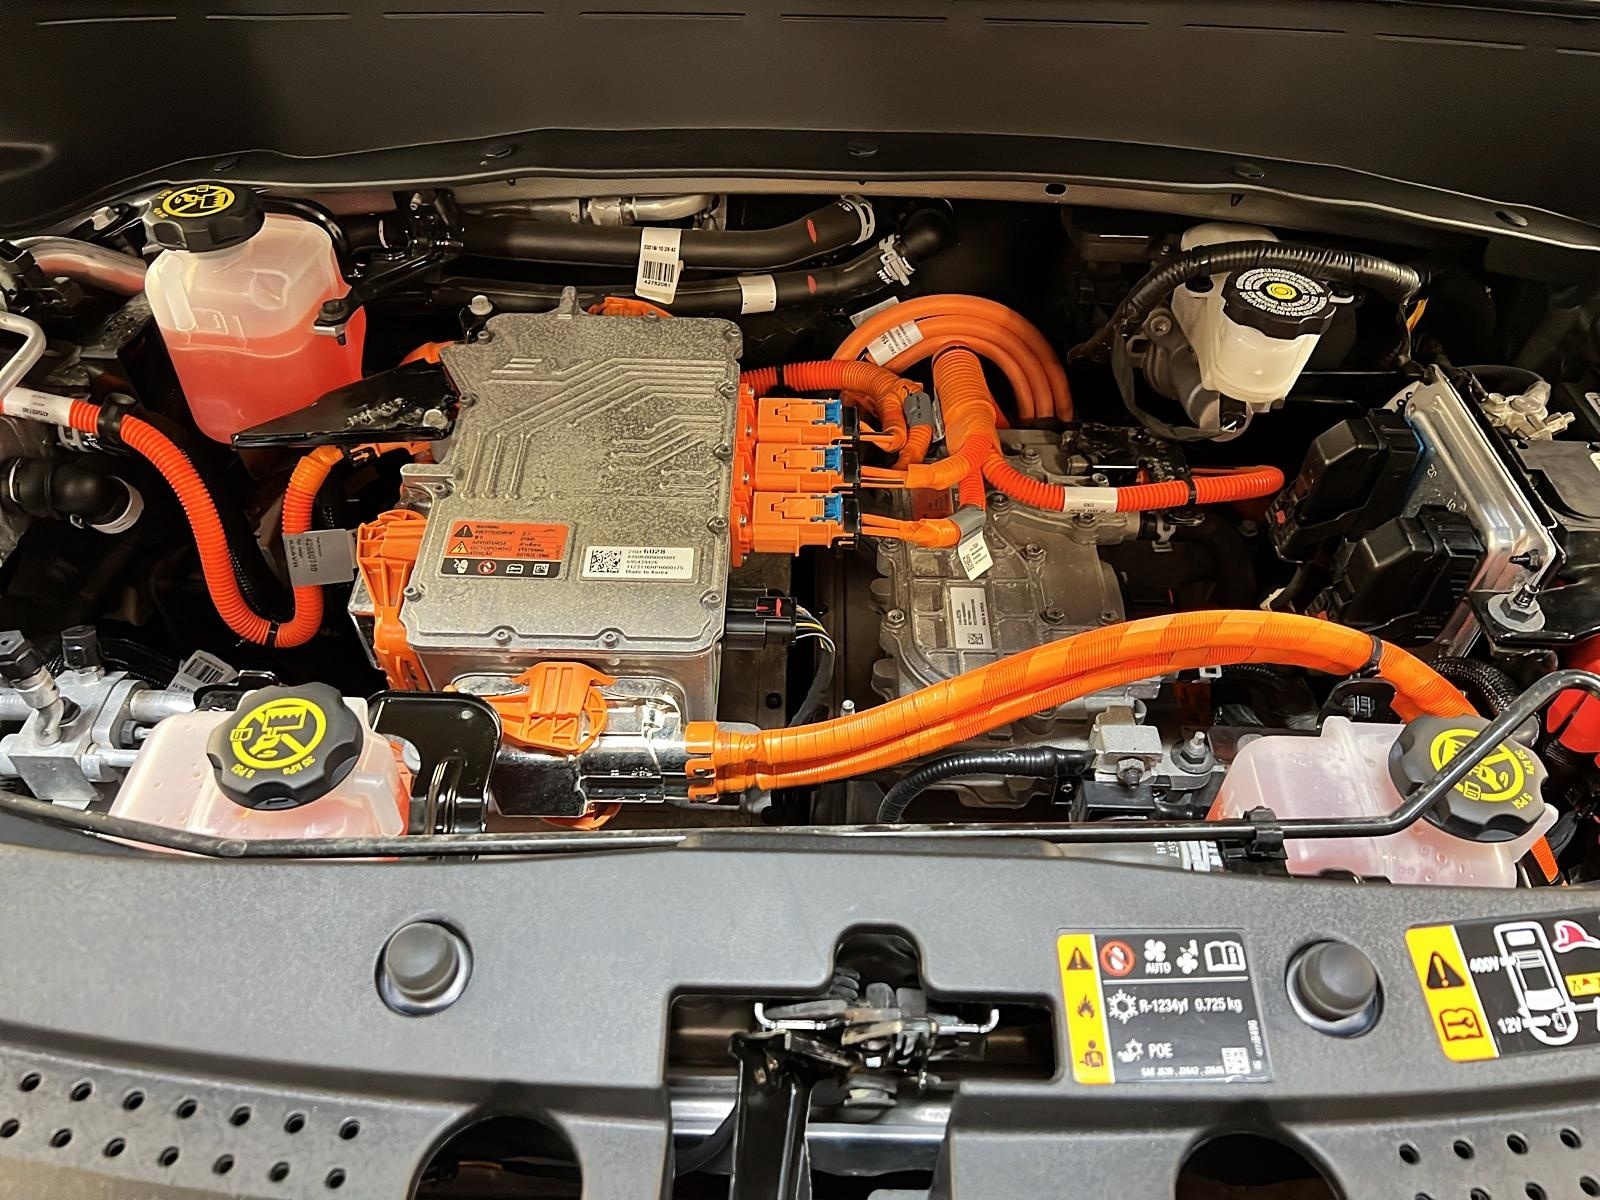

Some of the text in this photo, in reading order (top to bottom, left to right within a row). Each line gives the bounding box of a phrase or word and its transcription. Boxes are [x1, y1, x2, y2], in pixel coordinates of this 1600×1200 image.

[1145, 962, 1172, 974] AUTO
[1469, 955, 1500, 974] 400V
[1194, 997, 1227, 1013] 0.725
[1227, 997, 1243, 1014] kg
[1497, 1017, 1522, 1034] 12V
[1148, 1042, 1174, 1059] POE
